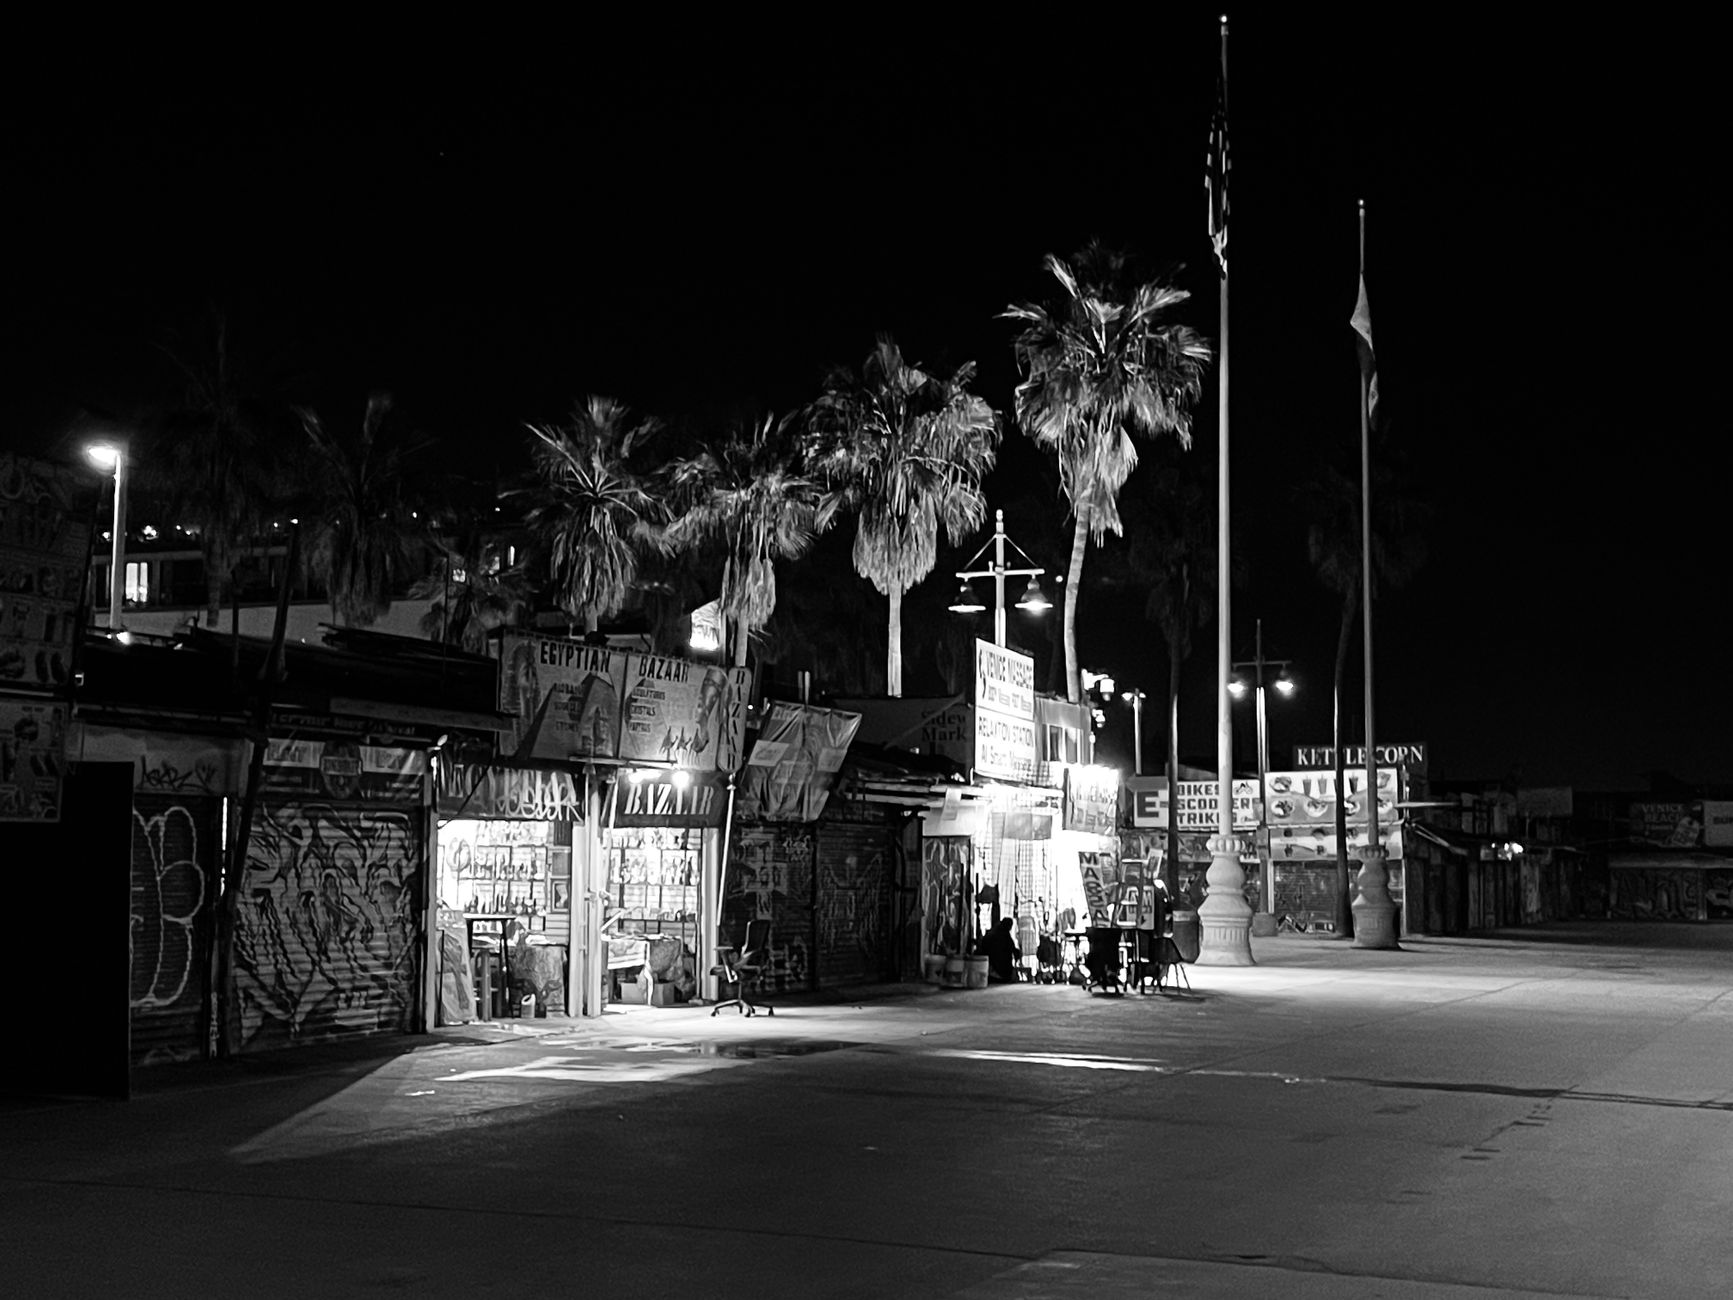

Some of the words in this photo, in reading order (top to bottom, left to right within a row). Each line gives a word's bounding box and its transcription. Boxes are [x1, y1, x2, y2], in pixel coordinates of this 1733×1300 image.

[540, 641, 612, 674] EGYPTIAN
[638, 655, 690, 684] BAZAAR
[1297, 751, 1367, 767] KETLE
[1375, 747, 1422, 766] CORN
[624, 784, 714, 815] BAZAAR
